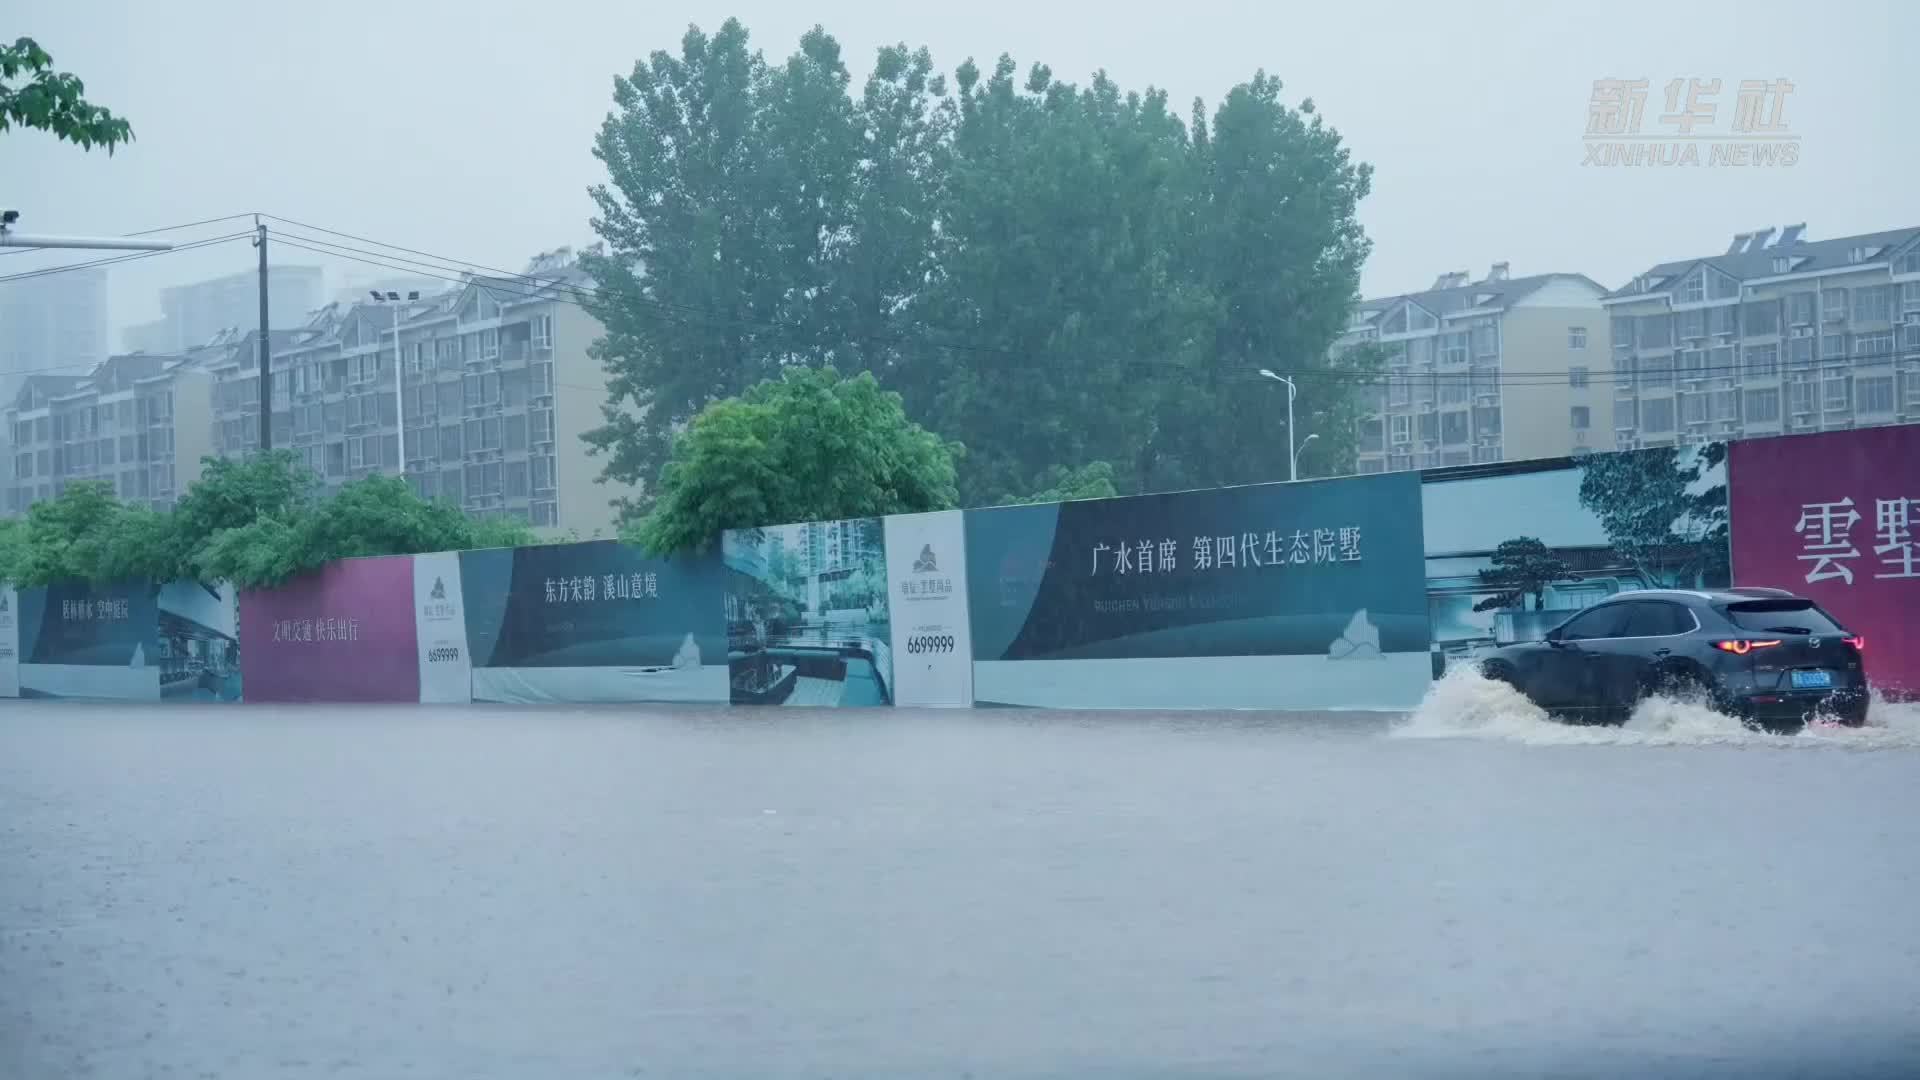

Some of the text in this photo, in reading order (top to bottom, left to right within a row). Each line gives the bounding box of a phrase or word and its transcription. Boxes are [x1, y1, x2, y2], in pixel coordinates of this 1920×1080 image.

[1091, 526, 1363, 577] 广水首席 第四代生态院墅
[1793, 496, 1920, 585] 雲墅
[543, 572, 658, 603] 东方宋韵 溪山意境
[271, 615, 361, 643] 文明交通 快乐出行
[427, 647, 459, 662] 6699999
[907, 634, 955, 654] 6699999
